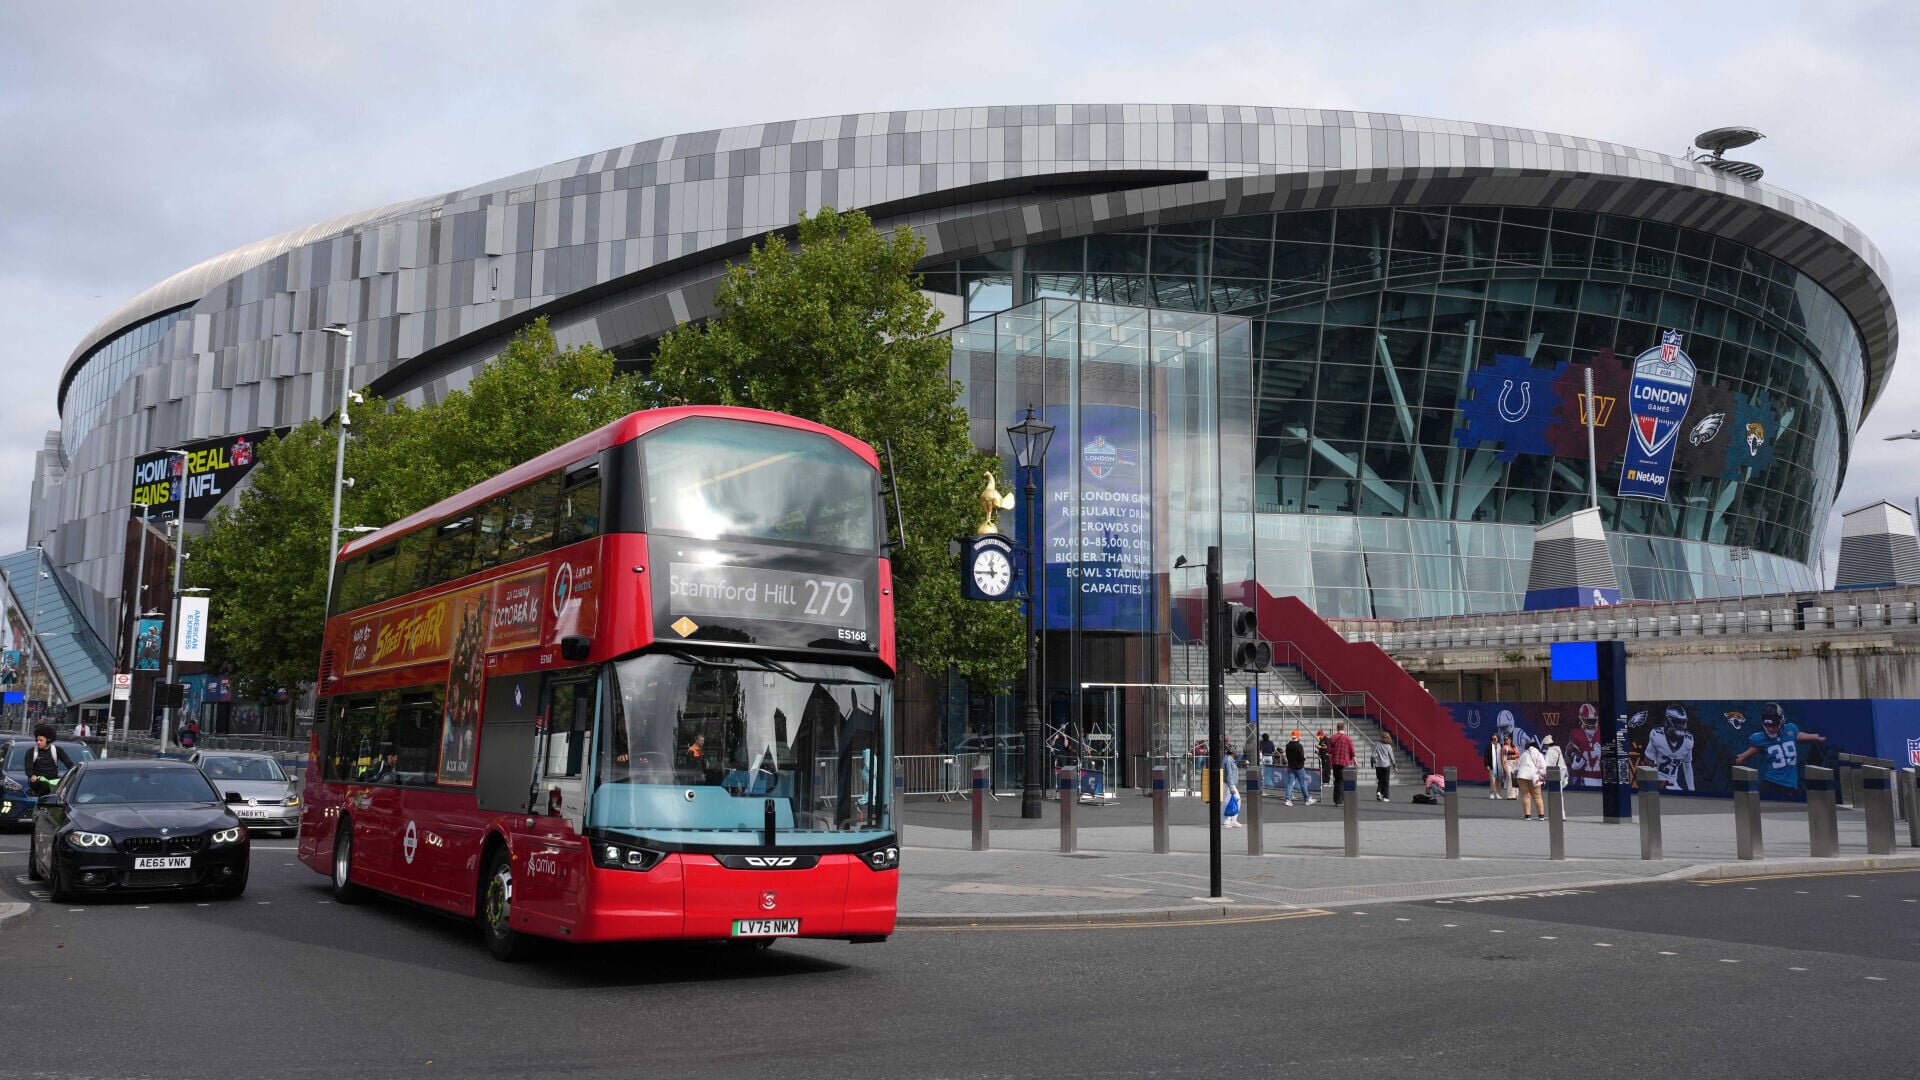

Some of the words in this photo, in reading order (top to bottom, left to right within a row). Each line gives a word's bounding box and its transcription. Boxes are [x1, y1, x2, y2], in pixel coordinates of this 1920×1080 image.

[1662, 345, 1676, 362] NFL
[1634, 385, 1687, 406] LONDON
[1648, 403, 1670, 413] GAMES
[136, 458, 168, 486] HOW
[187, 447, 229, 474] REAL
[1636, 470, 1664, 485] NetApp
[133, 482, 170, 509] FANS
[188, 473, 221, 499] NFL
[1080, 491, 1129, 502] LONDON
[1081, 522, 1129, 533] CROWDS
[1055, 553, 1097, 562] BIGGER
[1101, 553, 1131, 564] THAN
[1066, 567, 1102, 578] BOWL
[670, 575, 757, 602] Stamford
[764, 584, 797, 605] Hill
[804, 579, 853, 617] 279
[1081, 583, 1142, 595] CAPACITIES
[494, 600, 528, 628] OCTOBER
[529, 596, 538, 622] 16
[185, 614, 194, 650] EXPRESS
[191, 609, 201, 650] AMERICAN
[838, 629, 867, 642] ES168
[1767, 740, 1797, 769] 39
[139, 859, 165, 868] AE65
[168, 858, 187, 867] VNK
[535, 856, 556, 875] arriva
[740, 921, 771, 934] LV75
[774, 920, 796, 933] NMX
